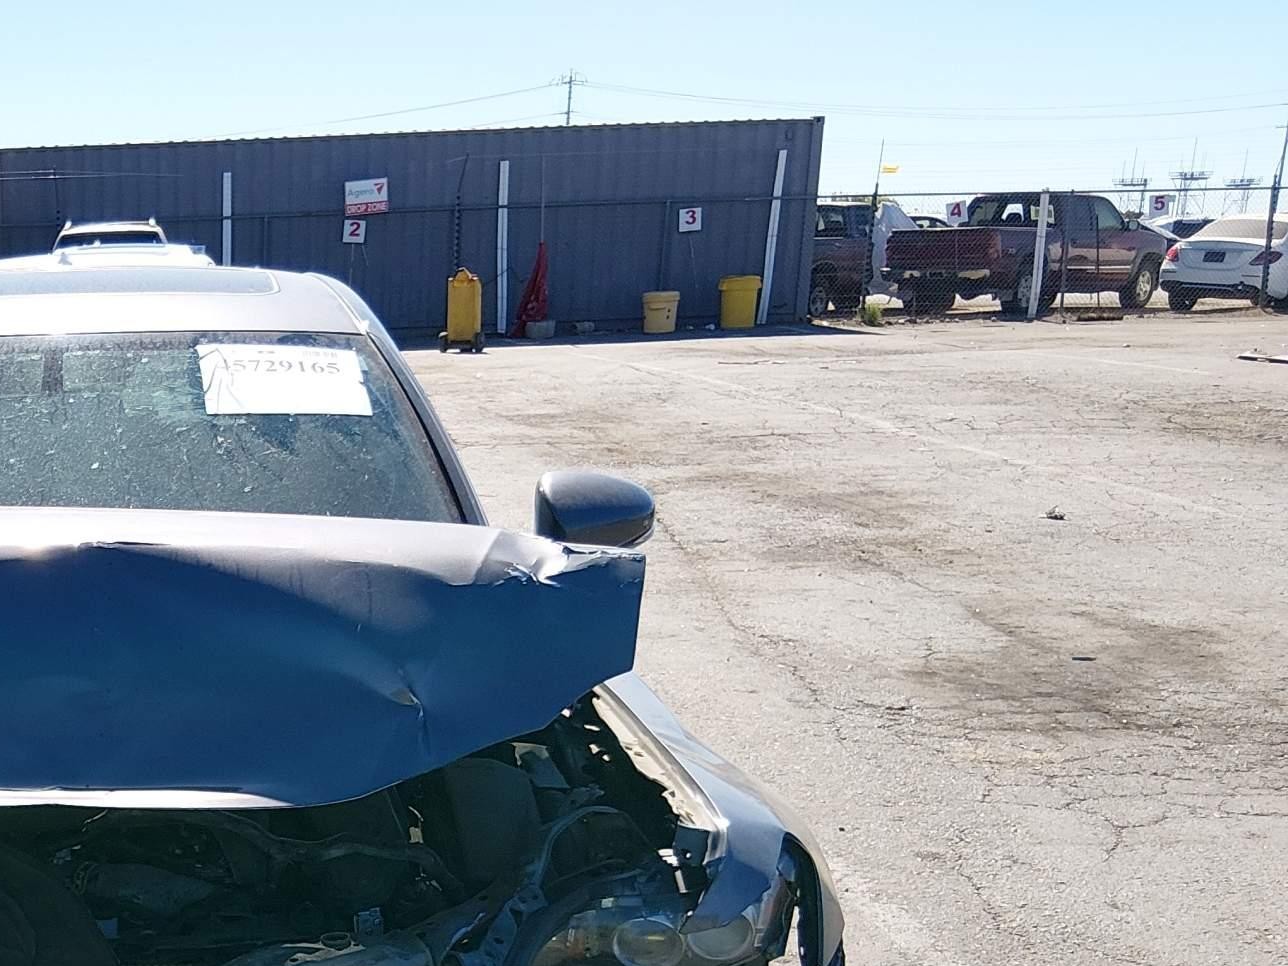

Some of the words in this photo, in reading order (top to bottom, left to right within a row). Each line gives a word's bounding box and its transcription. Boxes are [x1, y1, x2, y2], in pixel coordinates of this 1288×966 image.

[346, 204, 367, 214] DROP
[367, 202, 387, 212] ZONE
[950, 202, 962, 217] 4
[1153, 196, 1165, 211] 5
[685, 210, 697, 225] 3
[348, 222, 361, 237] 2
